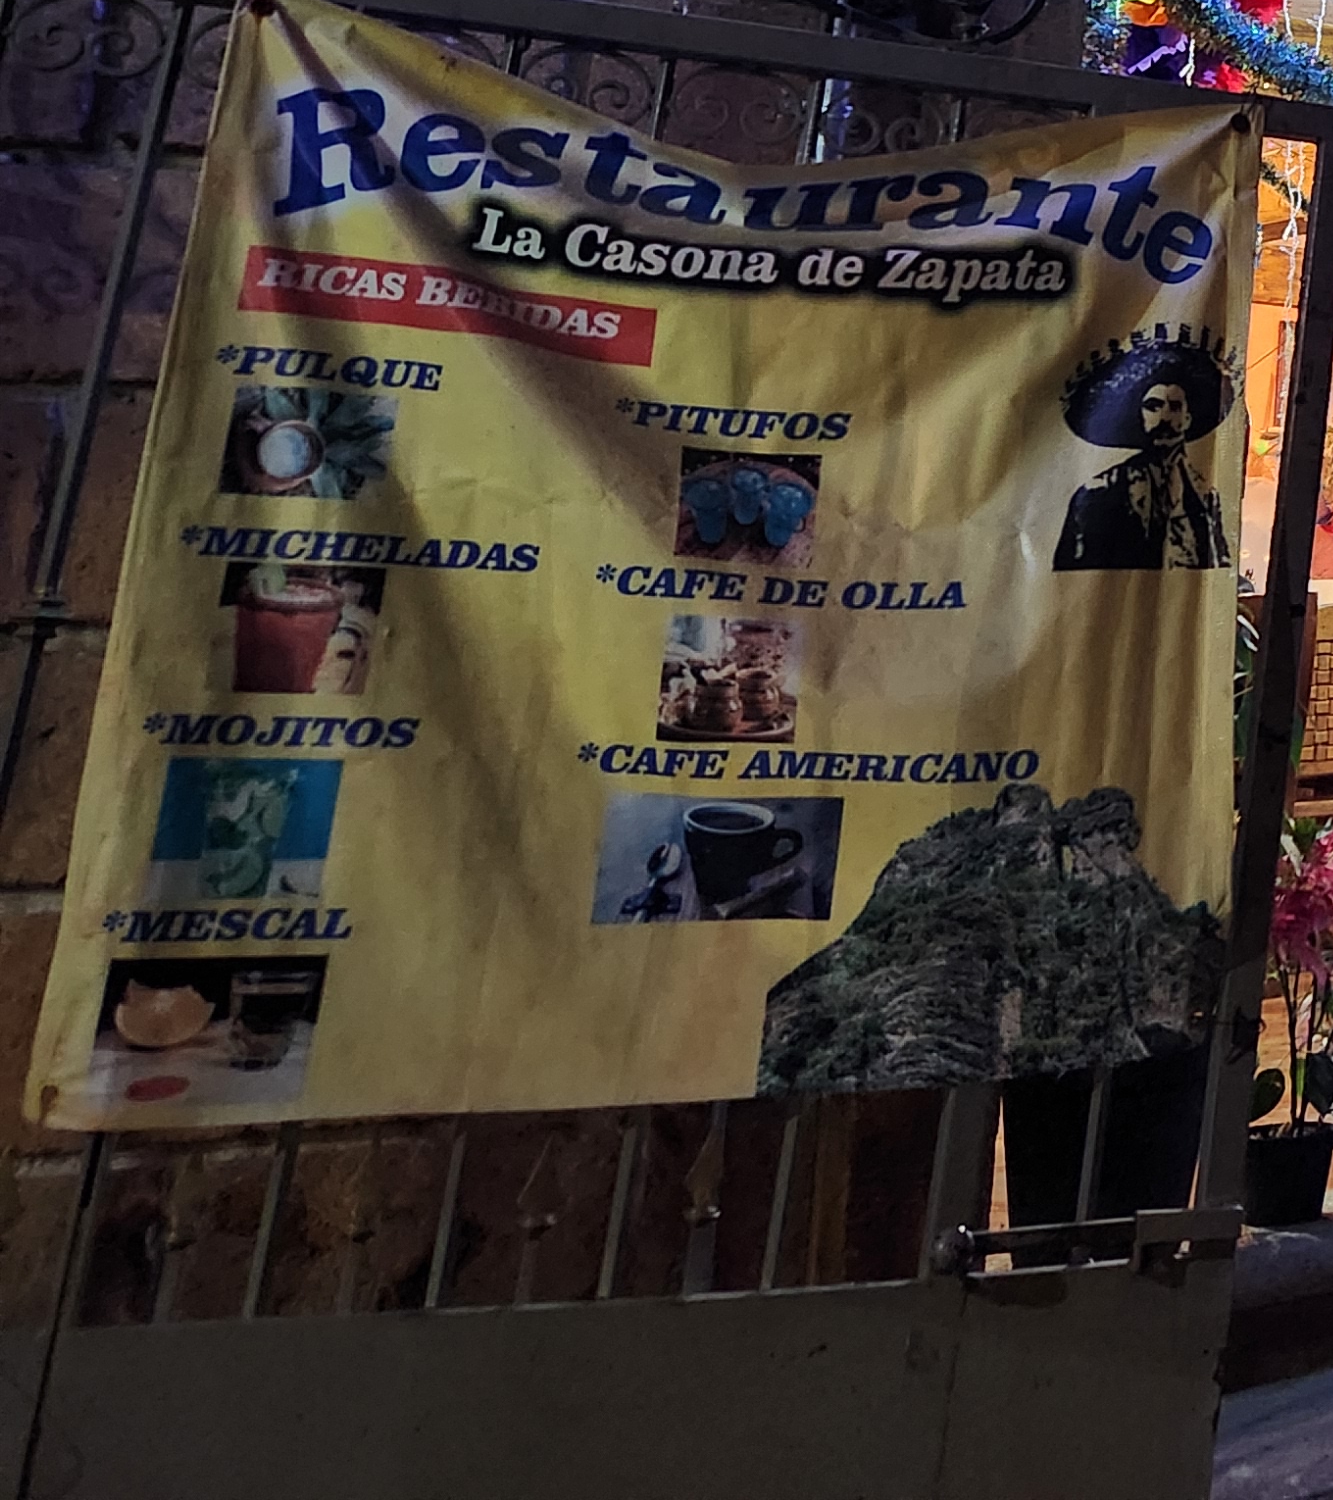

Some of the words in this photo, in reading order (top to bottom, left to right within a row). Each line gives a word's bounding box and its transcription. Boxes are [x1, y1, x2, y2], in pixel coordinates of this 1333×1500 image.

[273, 86, 1214, 284] Restaurante
[472, 207, 546, 260] La
[565, 222, 777, 284] Casona
[799, 246, 863, 288] de
[880, 247, 1066, 303] Zapata
[257, 257, 408, 302] RICAS
[758, 575, 829, 608] DE
[840, 580, 968, 610] OLLA
[737, 748, 1041, 784] AMERICANO
